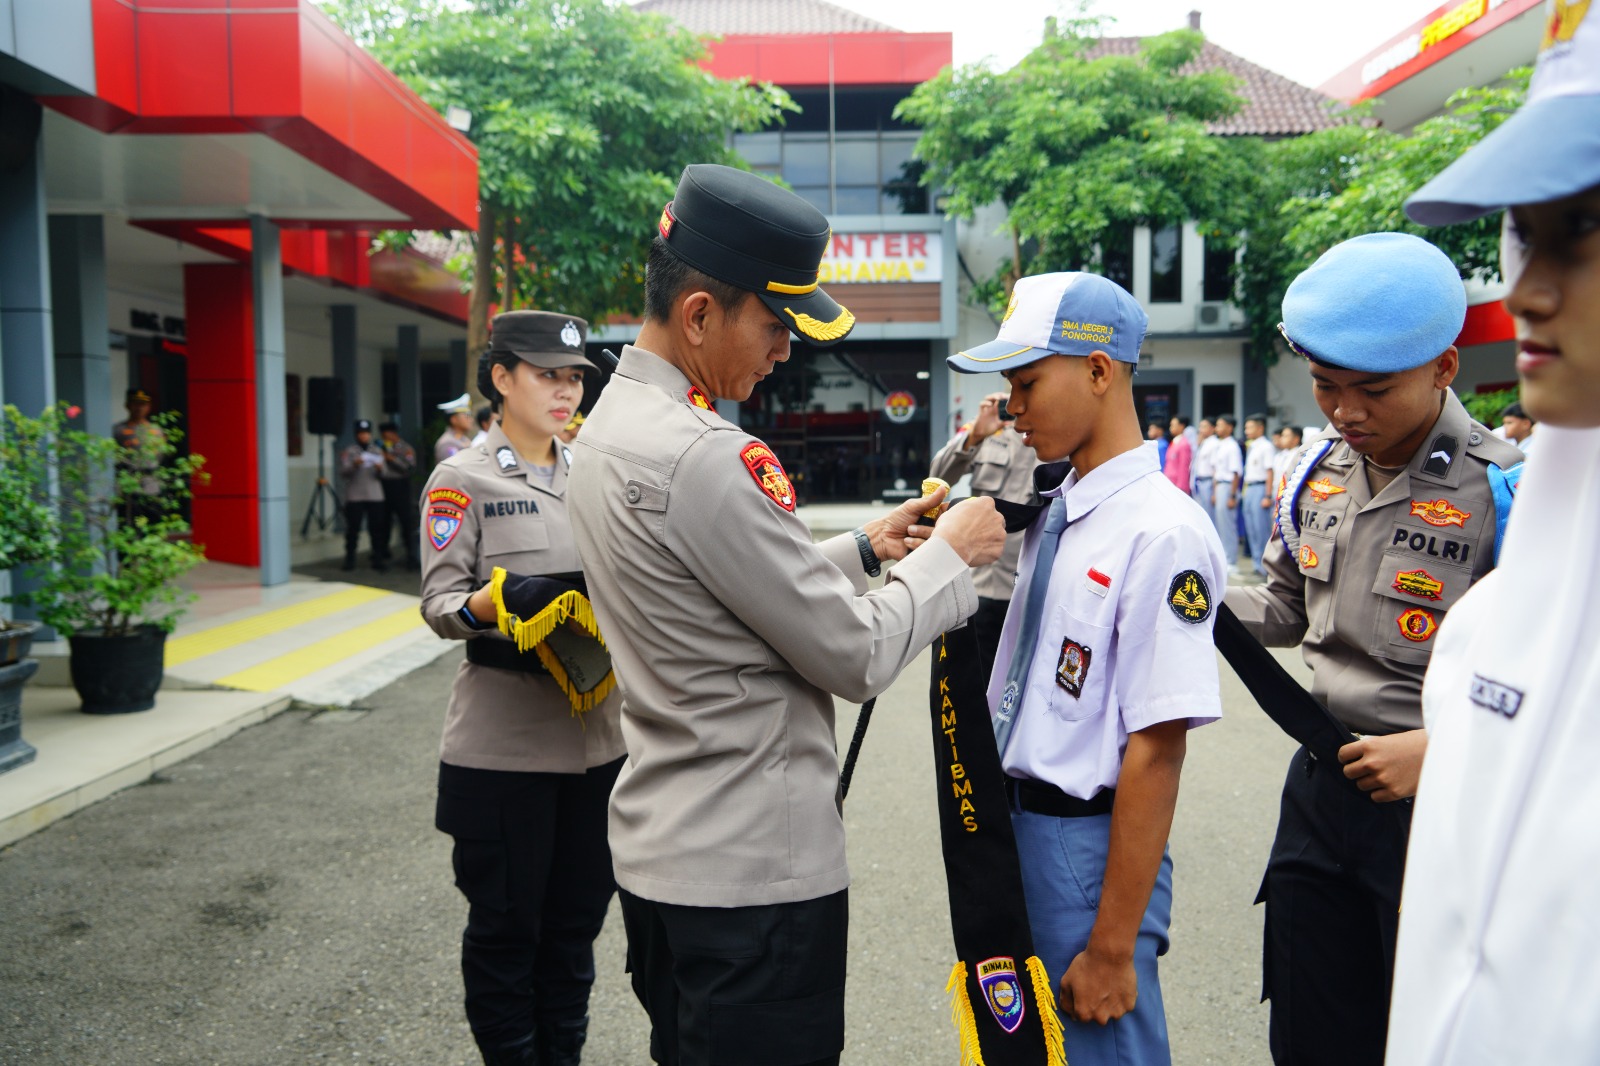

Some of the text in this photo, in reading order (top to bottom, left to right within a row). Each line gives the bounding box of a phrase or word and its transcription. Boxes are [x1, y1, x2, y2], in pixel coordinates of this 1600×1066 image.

[823, 232, 928, 257] NTER
[1062, 320, 1079, 330] SMA
[1081, 322, 1108, 334] NEGERI
[1061, 330, 1111, 344] PONOROGO
[483, 500, 539, 518] MEUTIA
[1324, 515, 1338, 531] P
[1392, 528, 1470, 562] POLRI
[939, 676, 978, 832] KAMTIBMAS
[982, 961, 1013, 974] BINMAS
